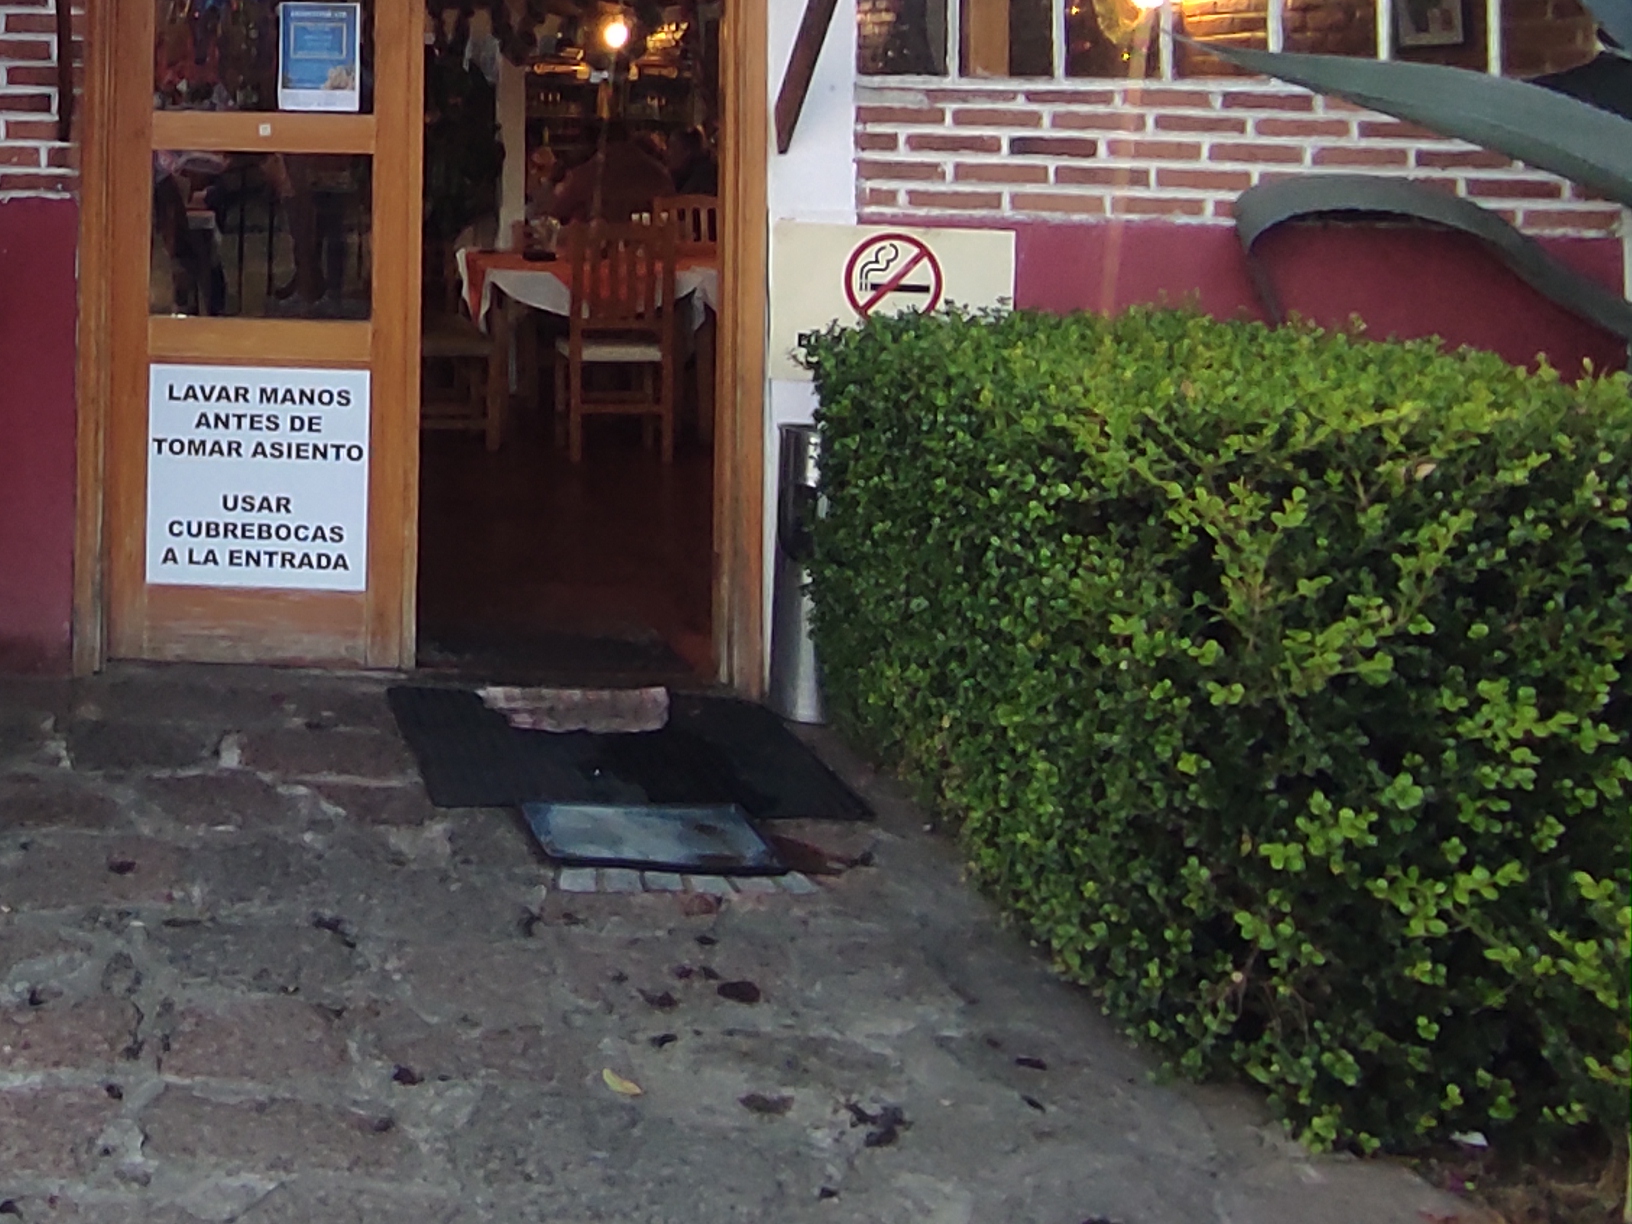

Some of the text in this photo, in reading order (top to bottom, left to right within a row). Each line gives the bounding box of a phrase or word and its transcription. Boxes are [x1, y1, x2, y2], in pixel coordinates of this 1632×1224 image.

[168, 383, 352, 407] LAVAR MANOS
[194, 412, 322, 433] ANTES DE
[152, 438, 364, 462] TOMAR ASIENTO
[222, 494, 292, 514] USAR
[168, 520, 344, 543] CUBREBOCAS
[161, 547, 350, 571] A LA ENTRADA
